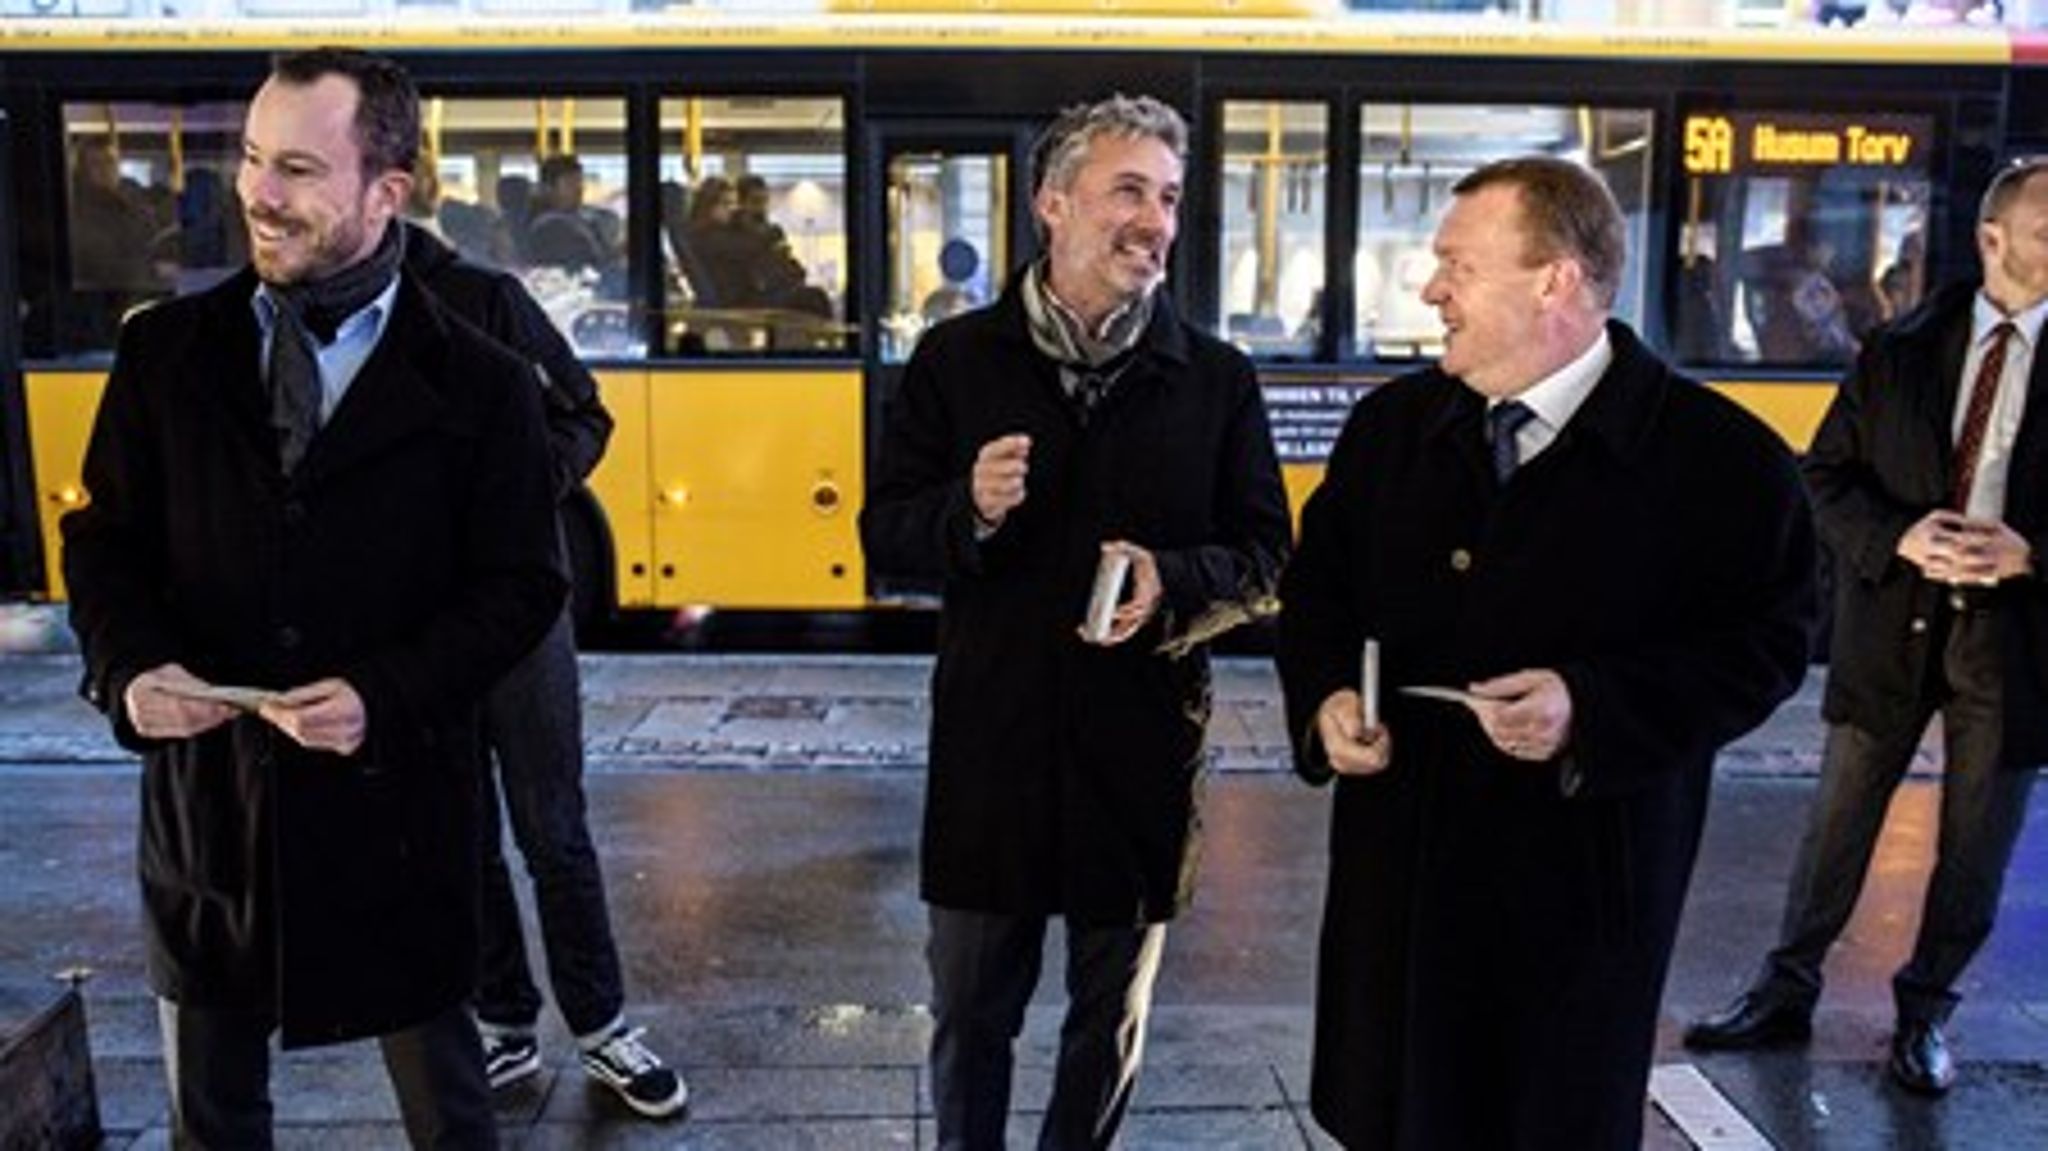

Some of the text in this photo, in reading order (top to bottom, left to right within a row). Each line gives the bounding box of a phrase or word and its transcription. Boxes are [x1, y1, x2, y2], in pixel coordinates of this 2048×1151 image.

[1684, 116, 1912, 173] 5A Husum Torv
